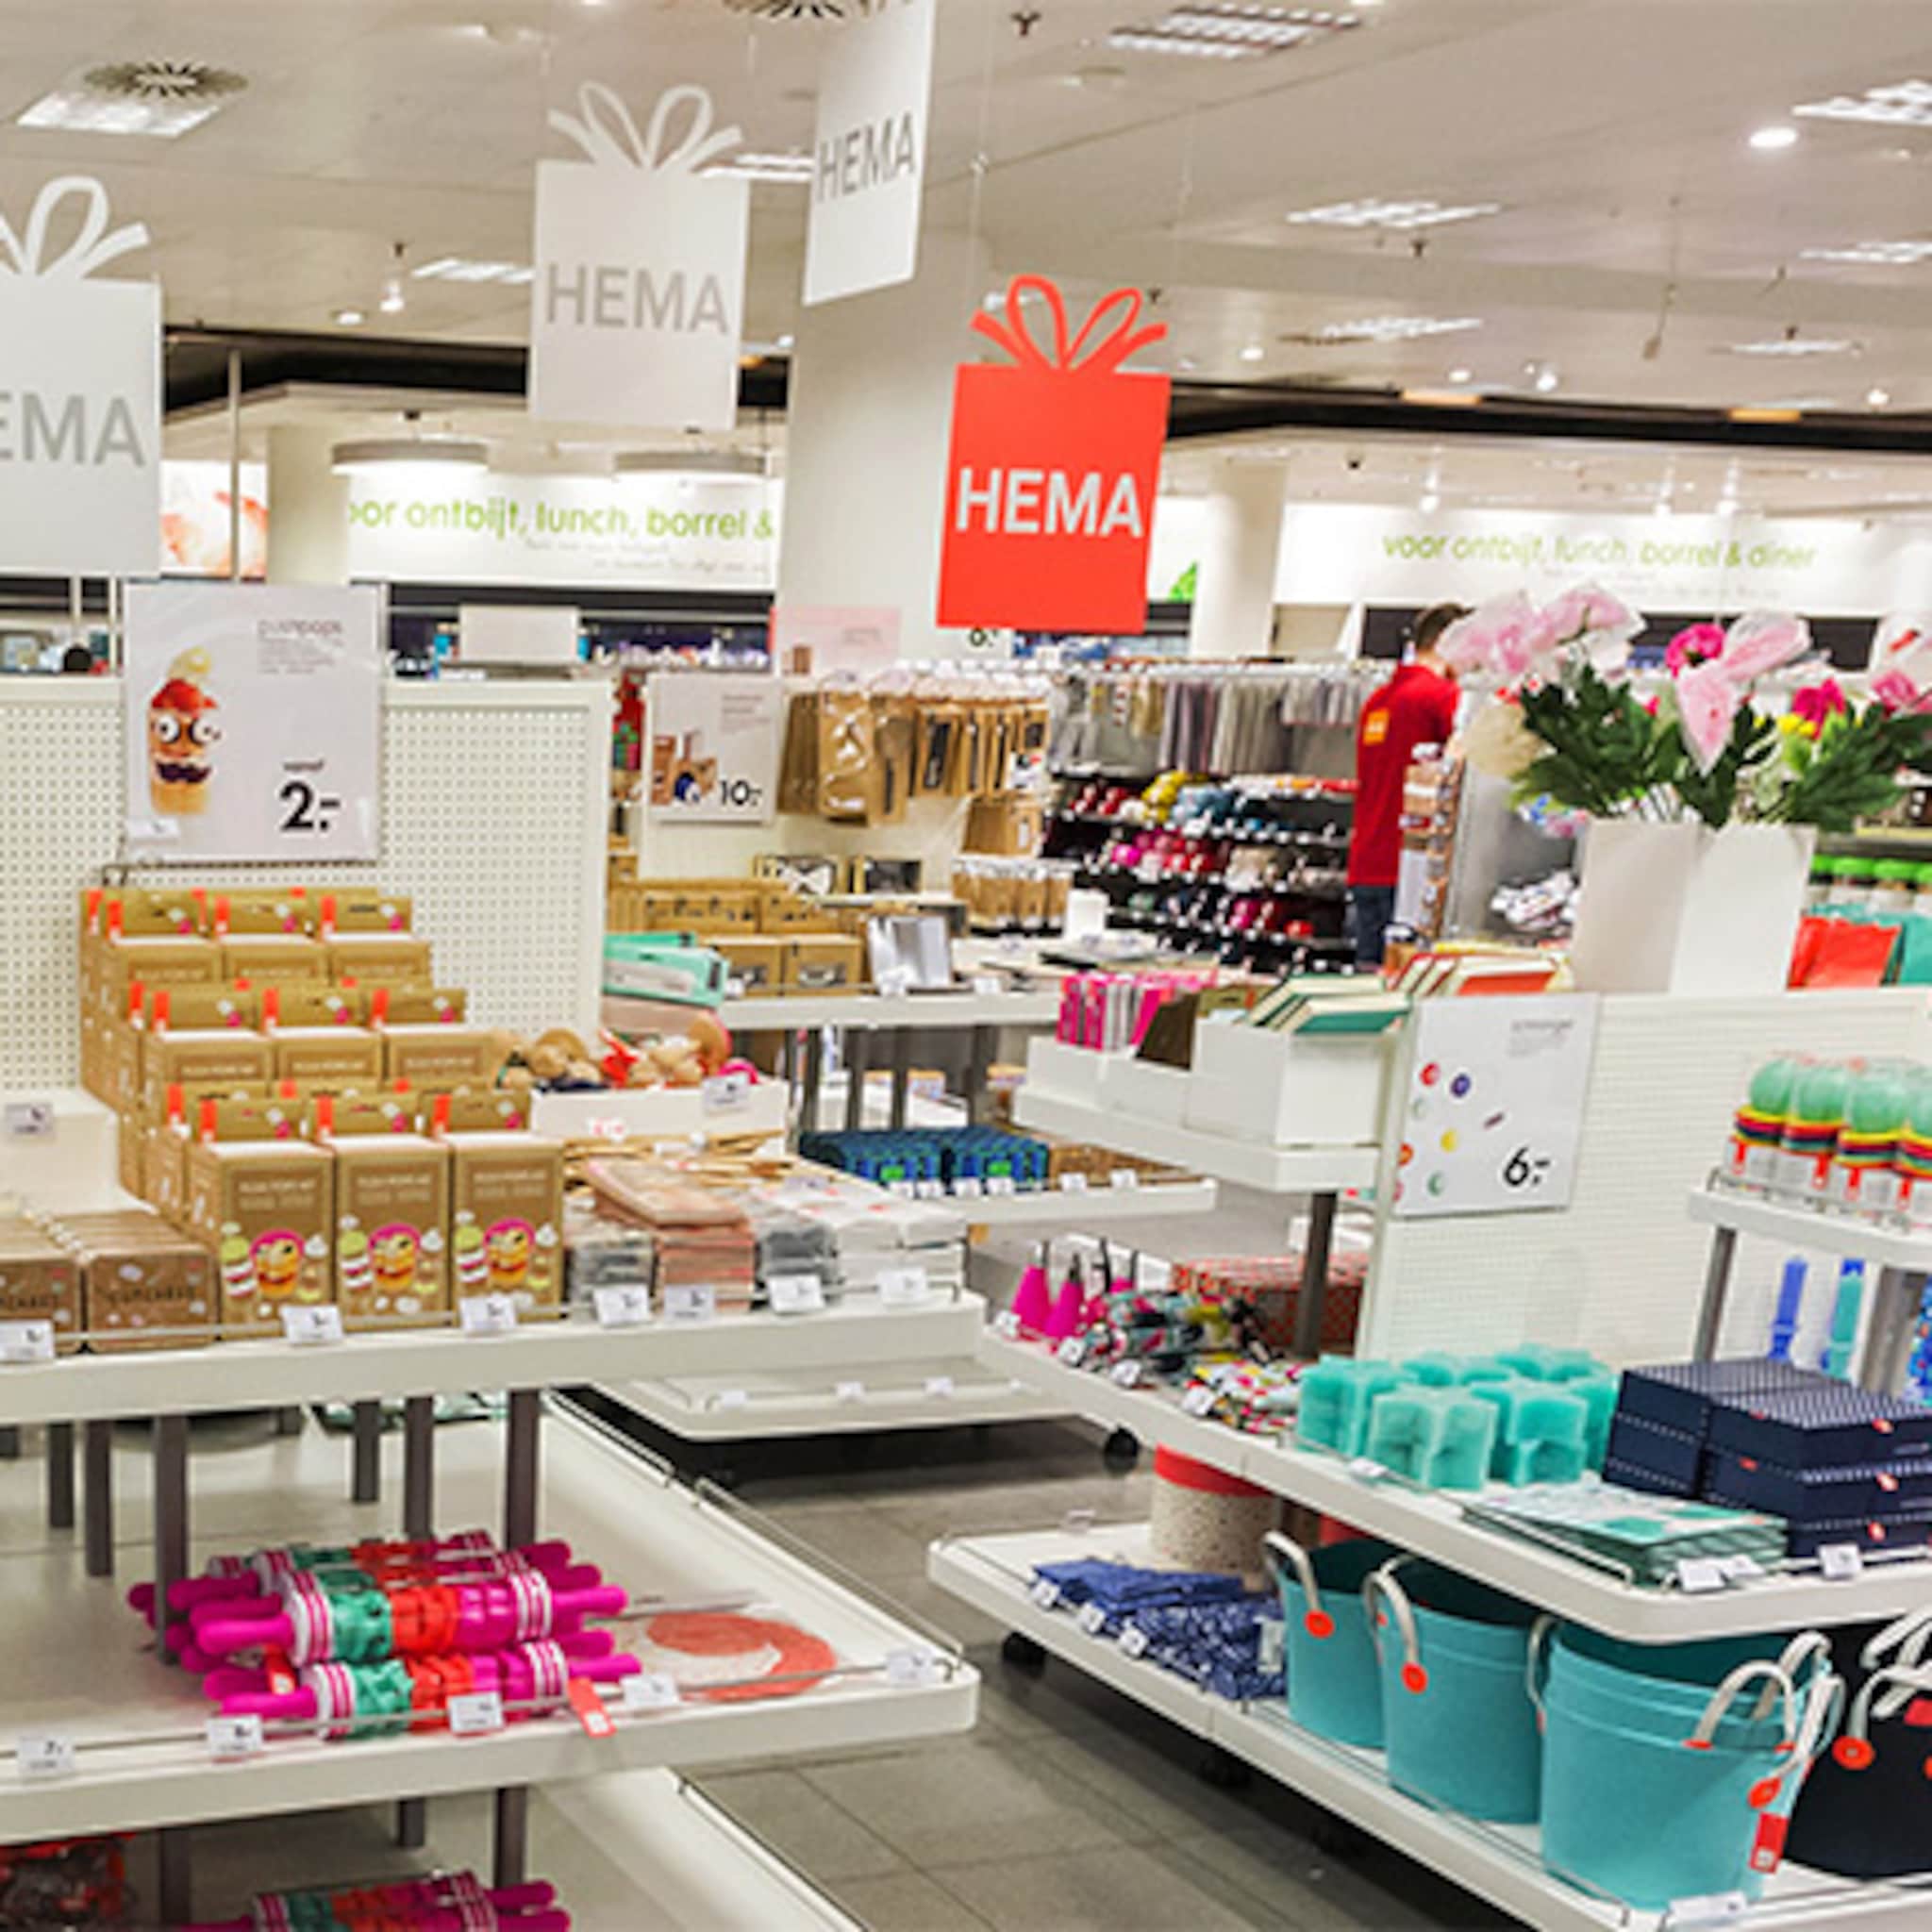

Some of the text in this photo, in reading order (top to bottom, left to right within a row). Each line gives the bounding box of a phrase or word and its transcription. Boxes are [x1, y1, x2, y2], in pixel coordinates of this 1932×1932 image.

[816, 111, 917, 202] HEMA
[546, 262, 727, 334] HEMA
[536, 501, 638, 539] lunch,
[646, 508, 747, 540] borrel
[754, 509, 774, 540] &
[955, 467, 1144, 538] HEMA
[1382, 535, 1447, 558] voor
